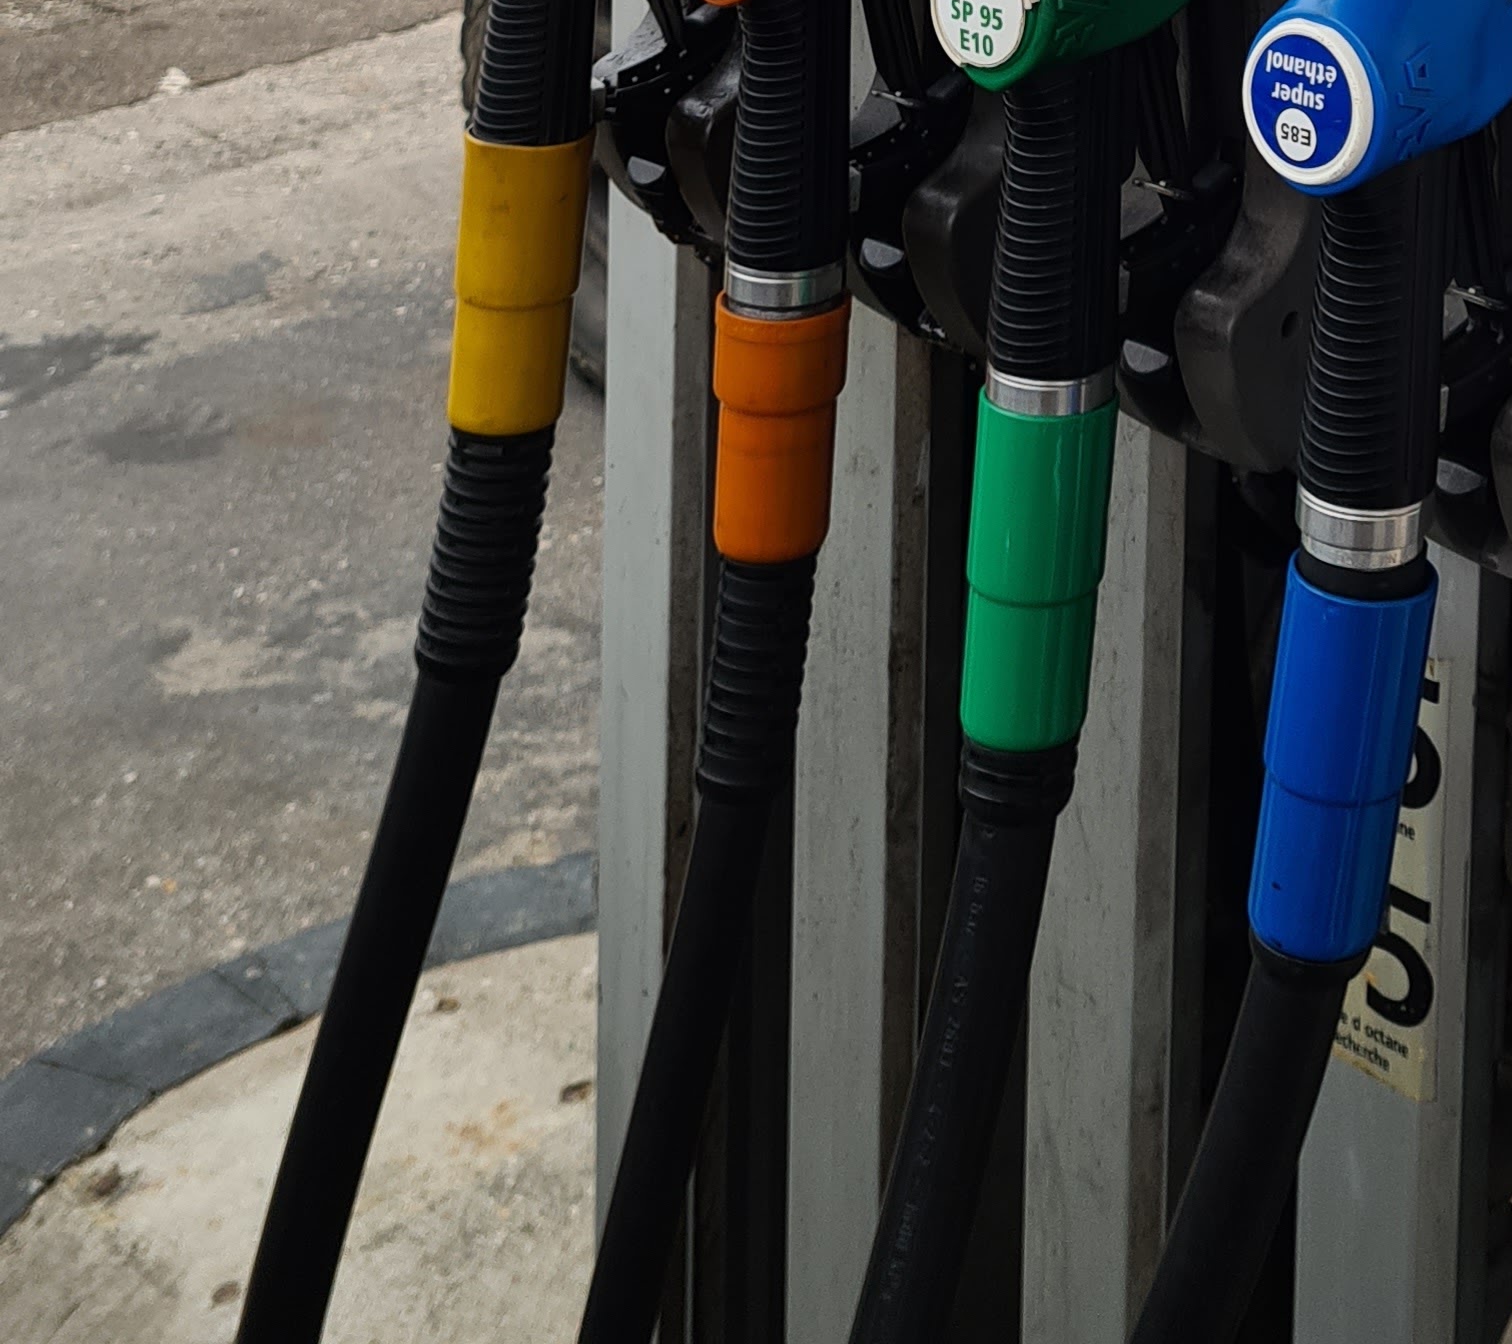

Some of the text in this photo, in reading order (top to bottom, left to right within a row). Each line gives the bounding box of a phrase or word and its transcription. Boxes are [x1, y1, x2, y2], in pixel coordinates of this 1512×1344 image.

[980, 5, 1003, 30] 95
[960, 28, 993, 56] E10
[1266, 50, 1337, 88] éthanol
[1272, 82, 1324, 110] super
[1281, 123, 1311, 146] E85
